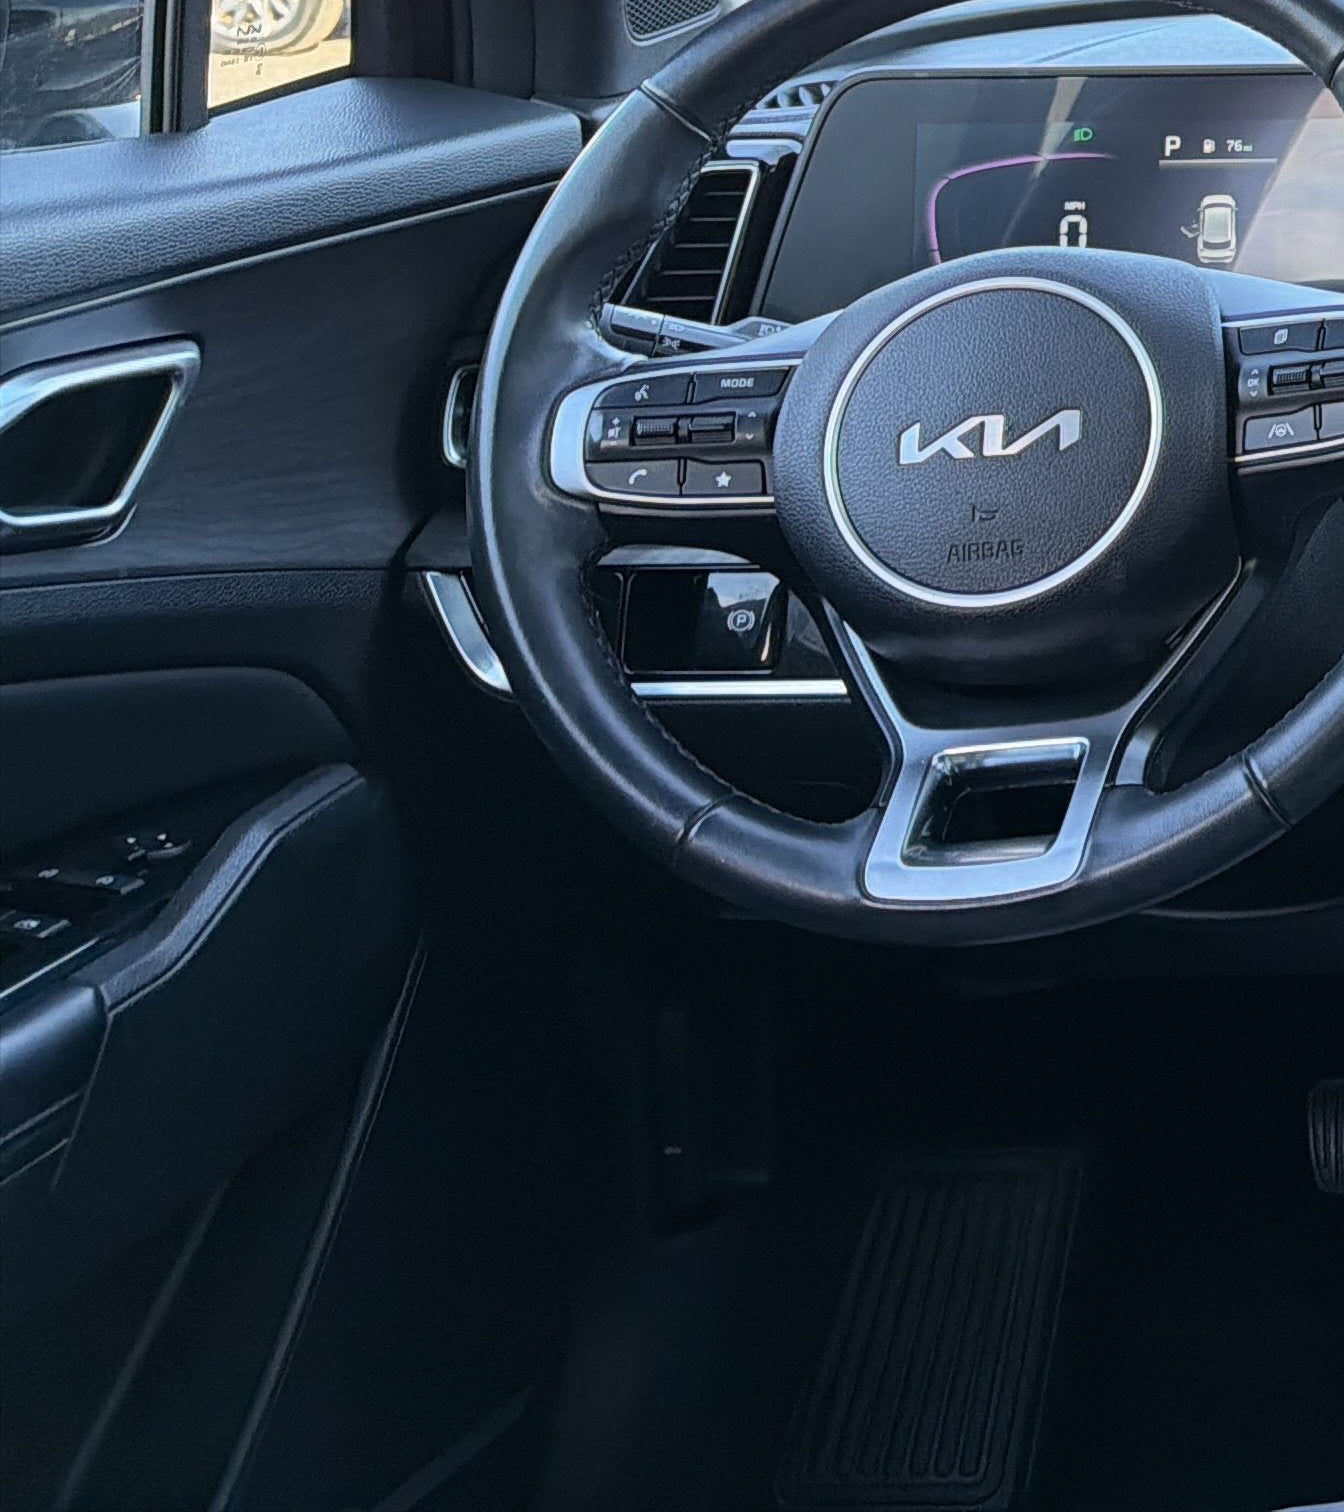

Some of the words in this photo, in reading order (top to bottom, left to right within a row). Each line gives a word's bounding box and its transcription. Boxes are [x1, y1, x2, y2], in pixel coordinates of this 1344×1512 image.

[1164, 135, 1181, 157] P
[1064, 200, 1086, 210] MPH
[1059, 214, 1088, 248] 0
[720, 377, 755, 388] MODE
[899, 409, 1081, 465] KIA
[947, 540, 1024, 563] AIRBAG
